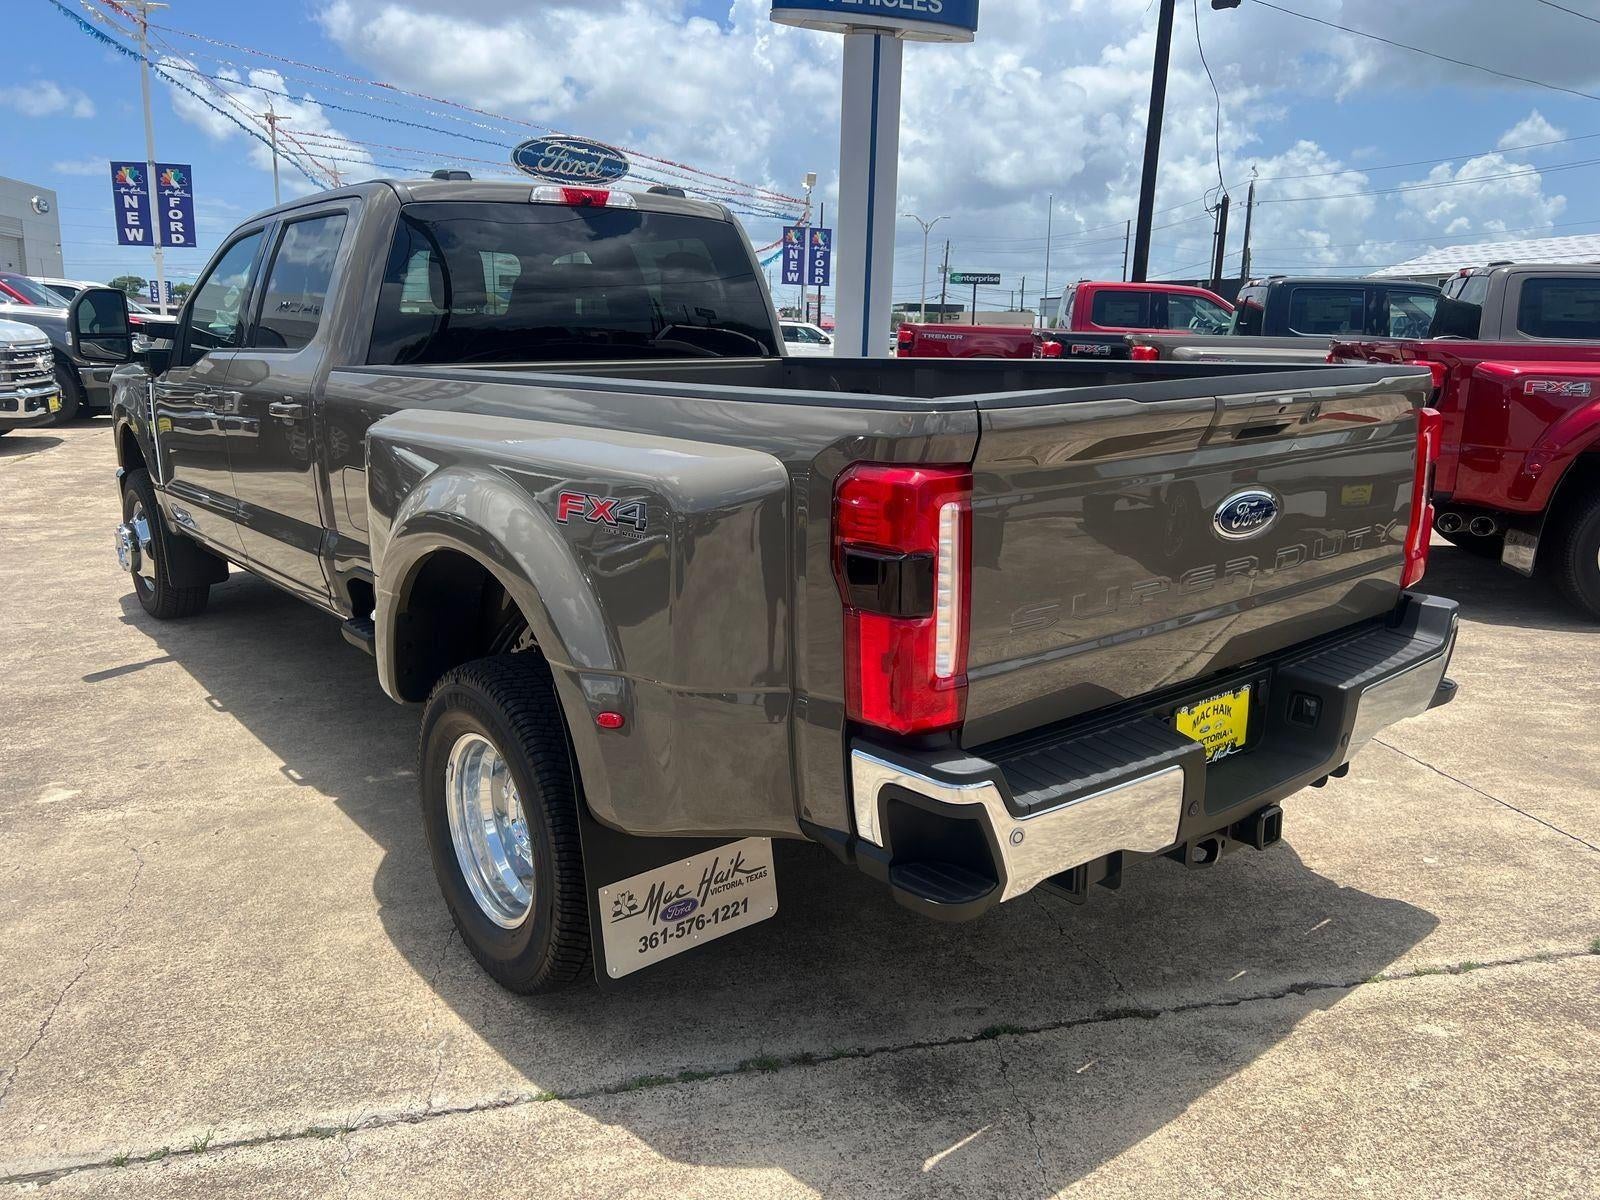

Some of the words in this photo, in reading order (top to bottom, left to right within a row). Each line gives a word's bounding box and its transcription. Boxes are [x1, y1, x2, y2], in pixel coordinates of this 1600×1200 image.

[537, 144, 604, 174] Ford
[123, 195, 143, 242] NEW
[168, 197, 185, 243] FORD
[787, 249, 800, 282] NEW
[814, 251, 825, 284] FORD
[952, 273, 999, 283] enterprise
[1071, 344, 1111, 356] FX4
[1524, 380, 1591, 396] FX4
[556, 489, 648, 533] FX4
[1231, 500, 1267, 529] Ford
[1010, 555, 1261, 634] SUPER
[1275, 518, 1397, 571] DUTY
[1191, 706, 1212, 731] MAC
[1212, 704, 1233, 718] HAIK
[640, 881, 692, 926] Mac
[697, 850, 767, 908] Haik
[710, 878, 744, 896] VICTORIA,
[745, 869, 768, 884] TEXAS
[638, 897, 749, 954] 361-576-1221
[666, 901, 692, 920] Ford
